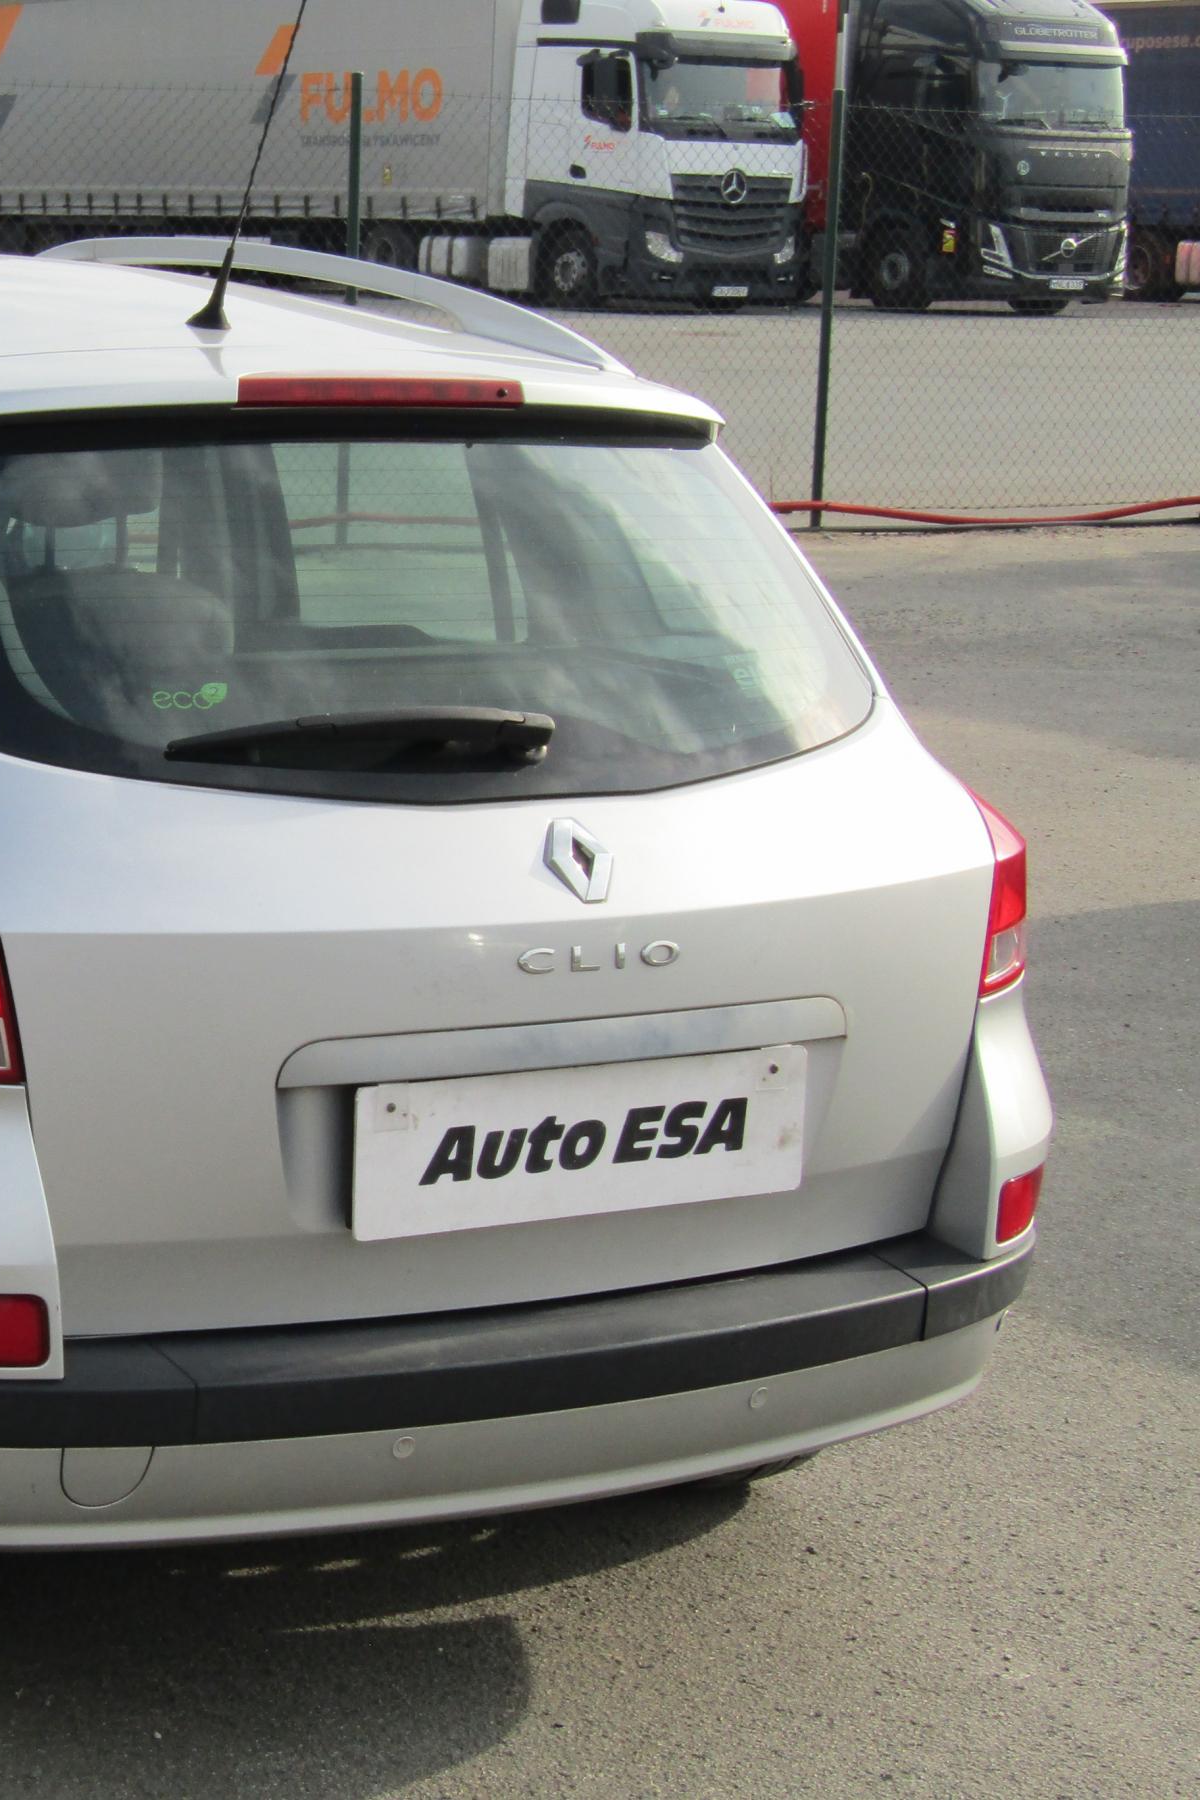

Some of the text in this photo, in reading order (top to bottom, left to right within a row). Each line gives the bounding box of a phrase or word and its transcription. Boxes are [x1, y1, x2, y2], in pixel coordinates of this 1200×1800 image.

[1014, 26, 1098, 40] GLOBETROTTER
[517, 940, 681, 974] CLIO
[418, 1096, 749, 1186] Auto ESA
